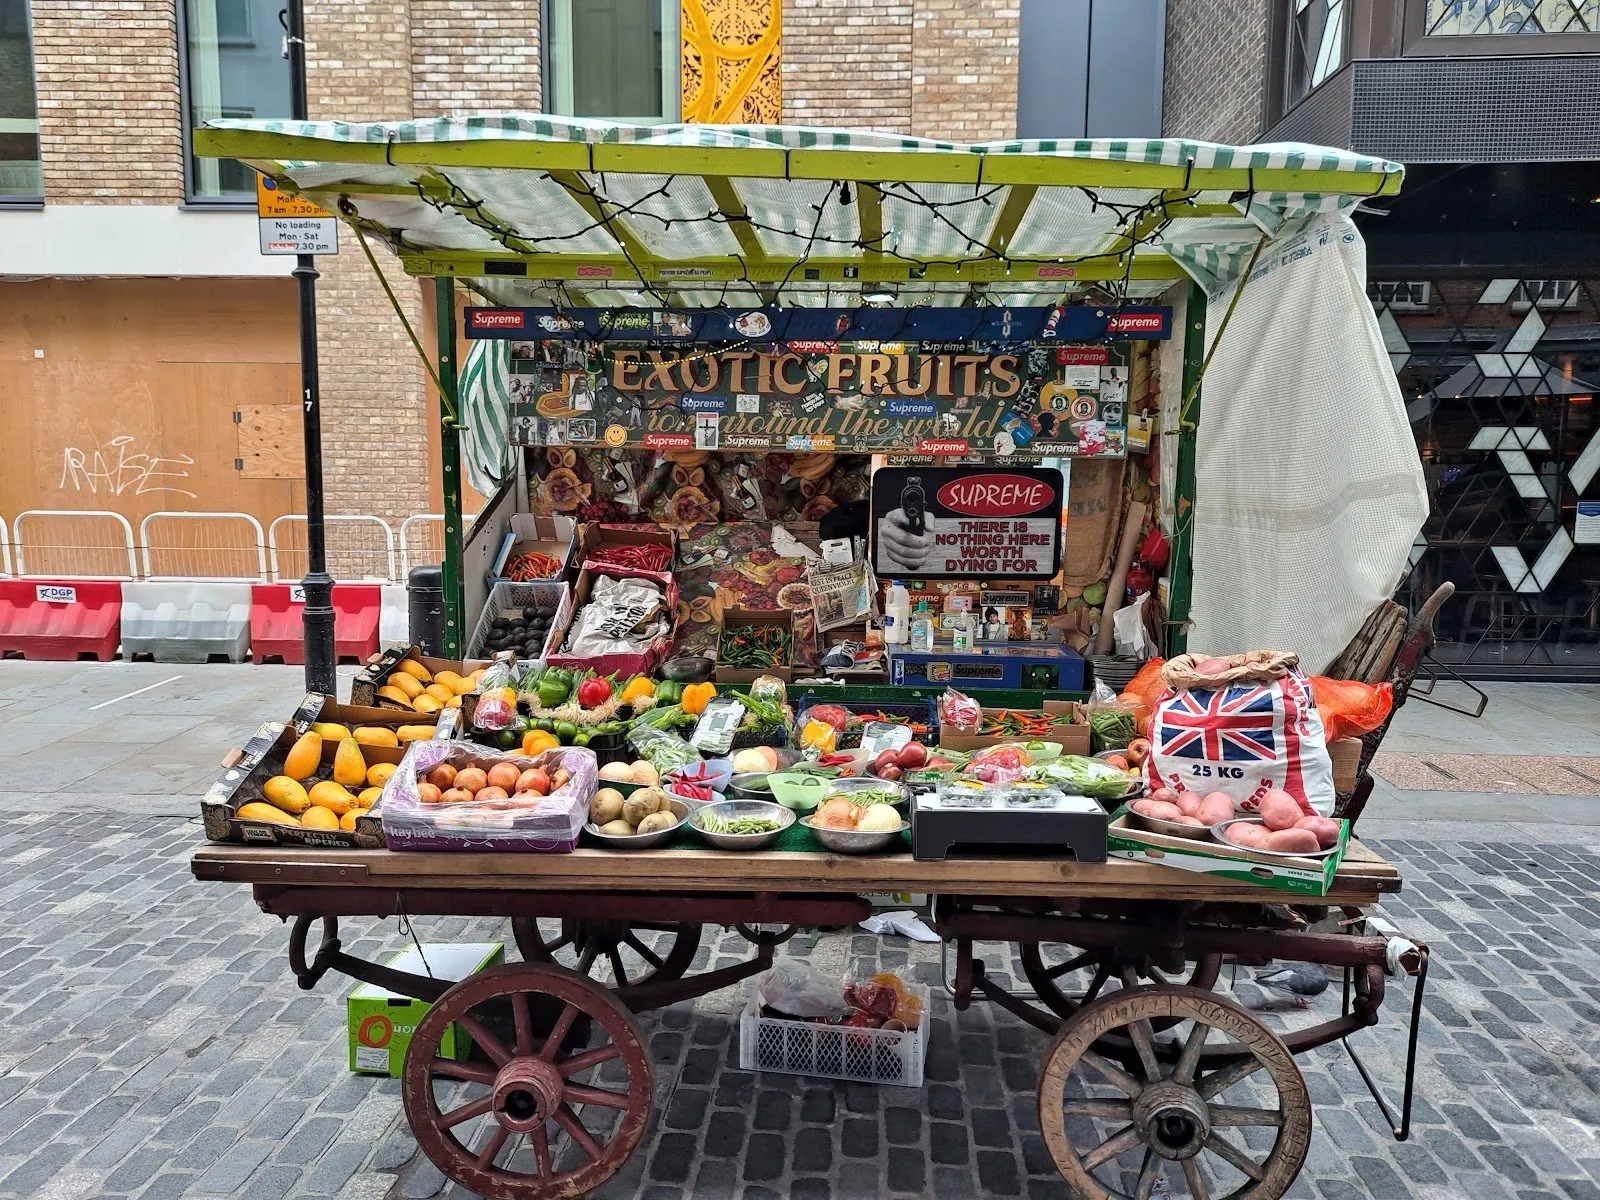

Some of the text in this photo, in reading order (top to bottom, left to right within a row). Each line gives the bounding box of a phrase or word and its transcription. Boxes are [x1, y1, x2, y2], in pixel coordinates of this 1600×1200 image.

[293, 206, 312, 214] 7.30
[290, 221, 321, 230] loading
[304, 232, 318, 240] Sat
[474, 315, 521, 325] Supreme
[1110, 318, 1160, 330] Supreme
[1060, 351, 1106, 363] Supreme
[612, 350, 807, 394] EXOTIC
[825, 352, 1021, 397] FRUITS
[681, 397, 725, 410] Supreme
[889, 401, 934, 415] Supreme
[837, 408, 892, 436] the
[646, 434, 690, 447] Supreme
[726, 435, 770, 448] Supreme
[787, 438, 833, 450] Supreme
[920, 440, 966, 453] Supreme
[1033, 441, 1079, 453] Supreme
[949, 483, 1043, 507] SUPREME
[958, 521, 1029, 533] THERE IS
[935, 534, 1051, 546] NOTHING HERE
[959, 547, 1024, 559] WORTH
[945, 560, 1038, 572] DYING FOR
[51, 588, 73, 596] DGP
[983, 591, 1028, 604] Supreme
[954, 663, 1001, 677] Supreme
[1192, 764, 1244, 779] 25 KG
[281, 828, 338, 841] PERFECTLY
[304, 836, 350, 848] RIPENED
